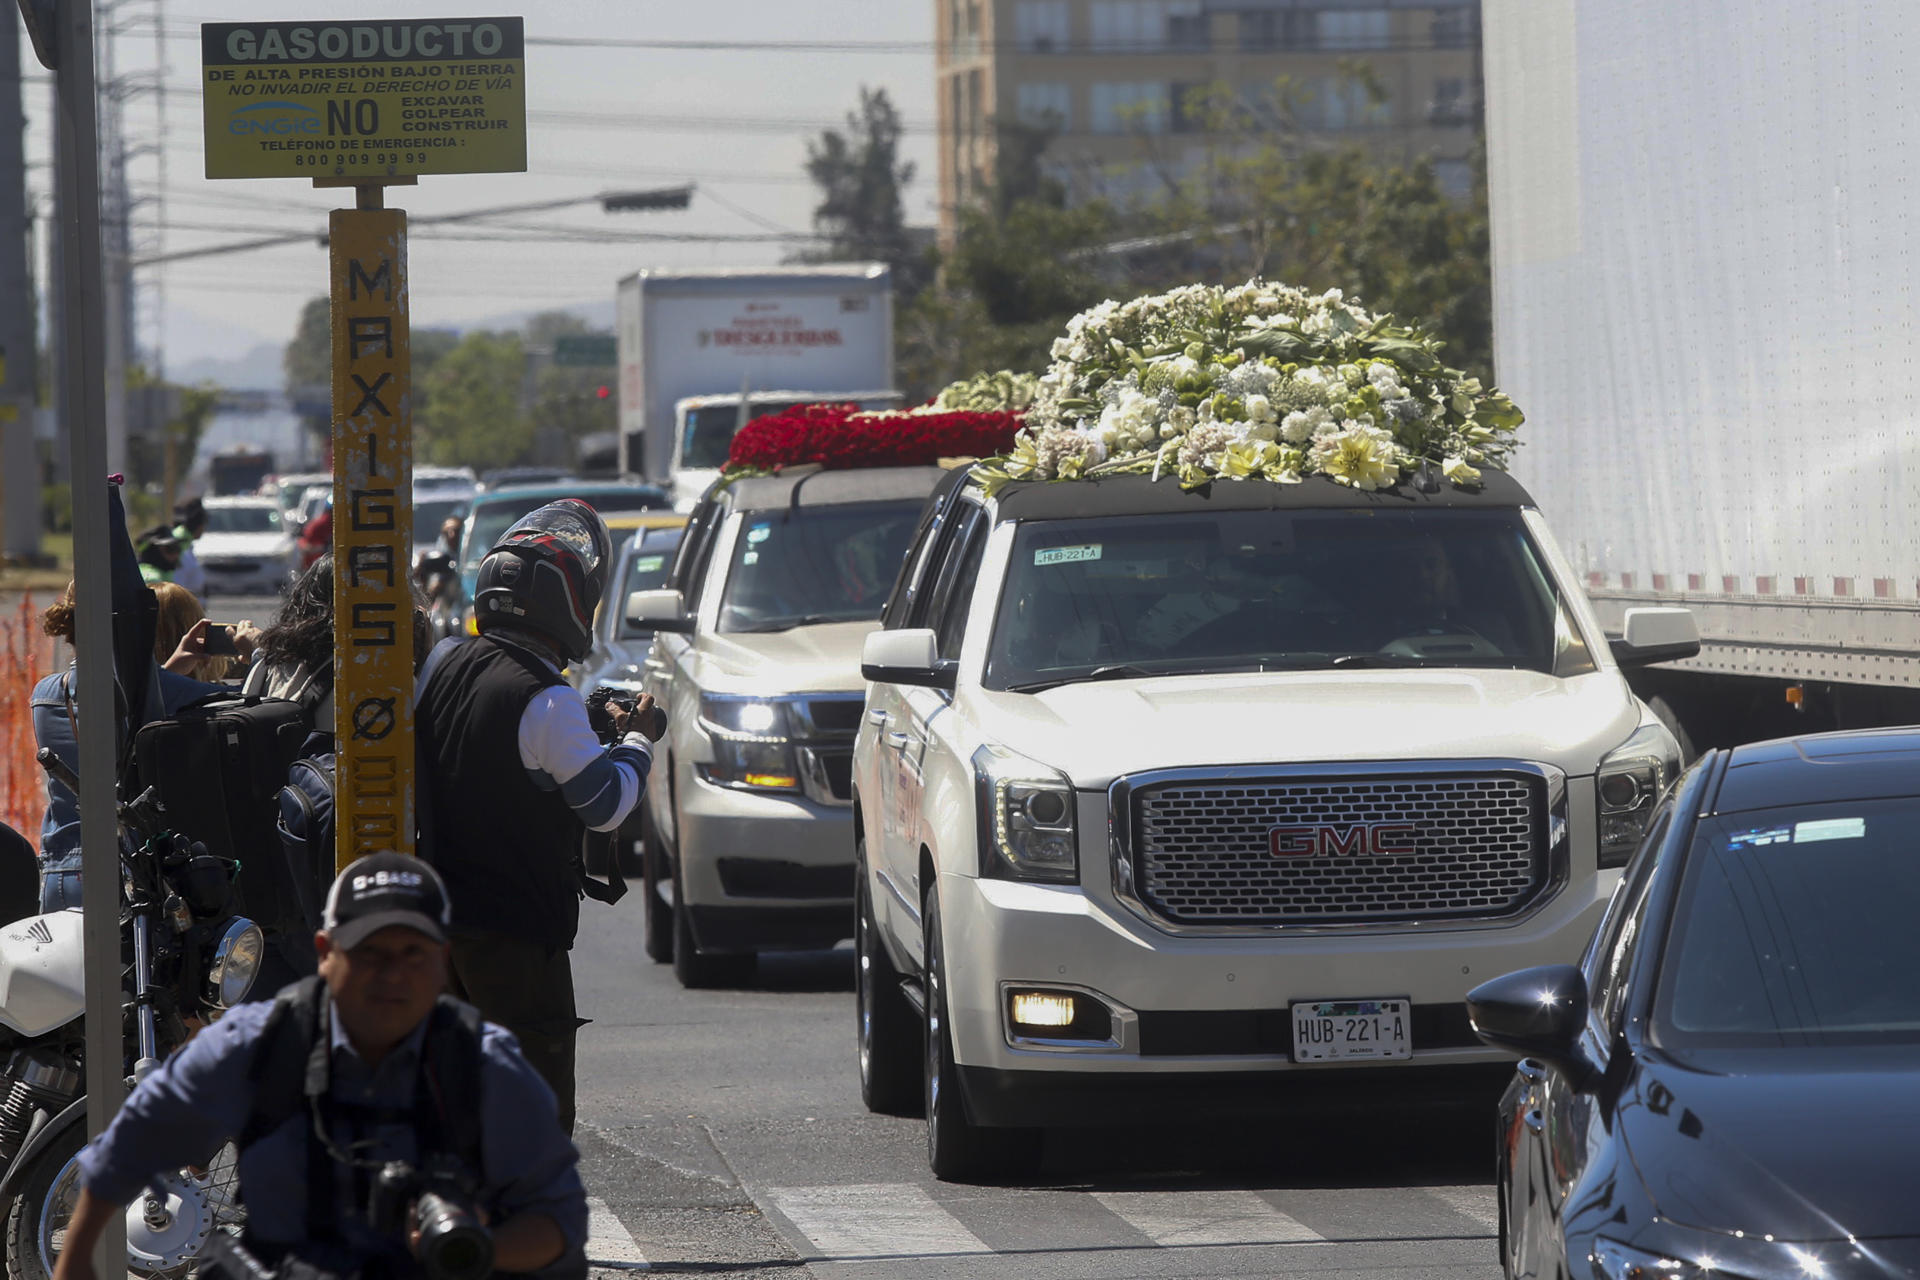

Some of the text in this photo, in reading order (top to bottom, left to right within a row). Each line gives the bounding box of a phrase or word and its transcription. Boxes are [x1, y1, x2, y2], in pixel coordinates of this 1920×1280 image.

[226, 23, 503, 60] GASODUCTO
[208, 63, 516, 81] DE ALTA PRESIÓN BAJO TIERRA
[228, 76, 512, 96] NO INVADIR EL DERECHO DE VÍA
[402, 95, 484, 107] EXCAVAR
[327, 98, 379, 136] NO
[402, 108, 486, 120] GOLPEAR
[402, 119, 509, 132] CONSTRUIR
[260, 138, 336, 151] TELÉFONO
[340, 139, 359, 150] DE
[1268, 823, 1416, 858] GMC
[1298, 1016, 1404, 1044] HUB-221-A
